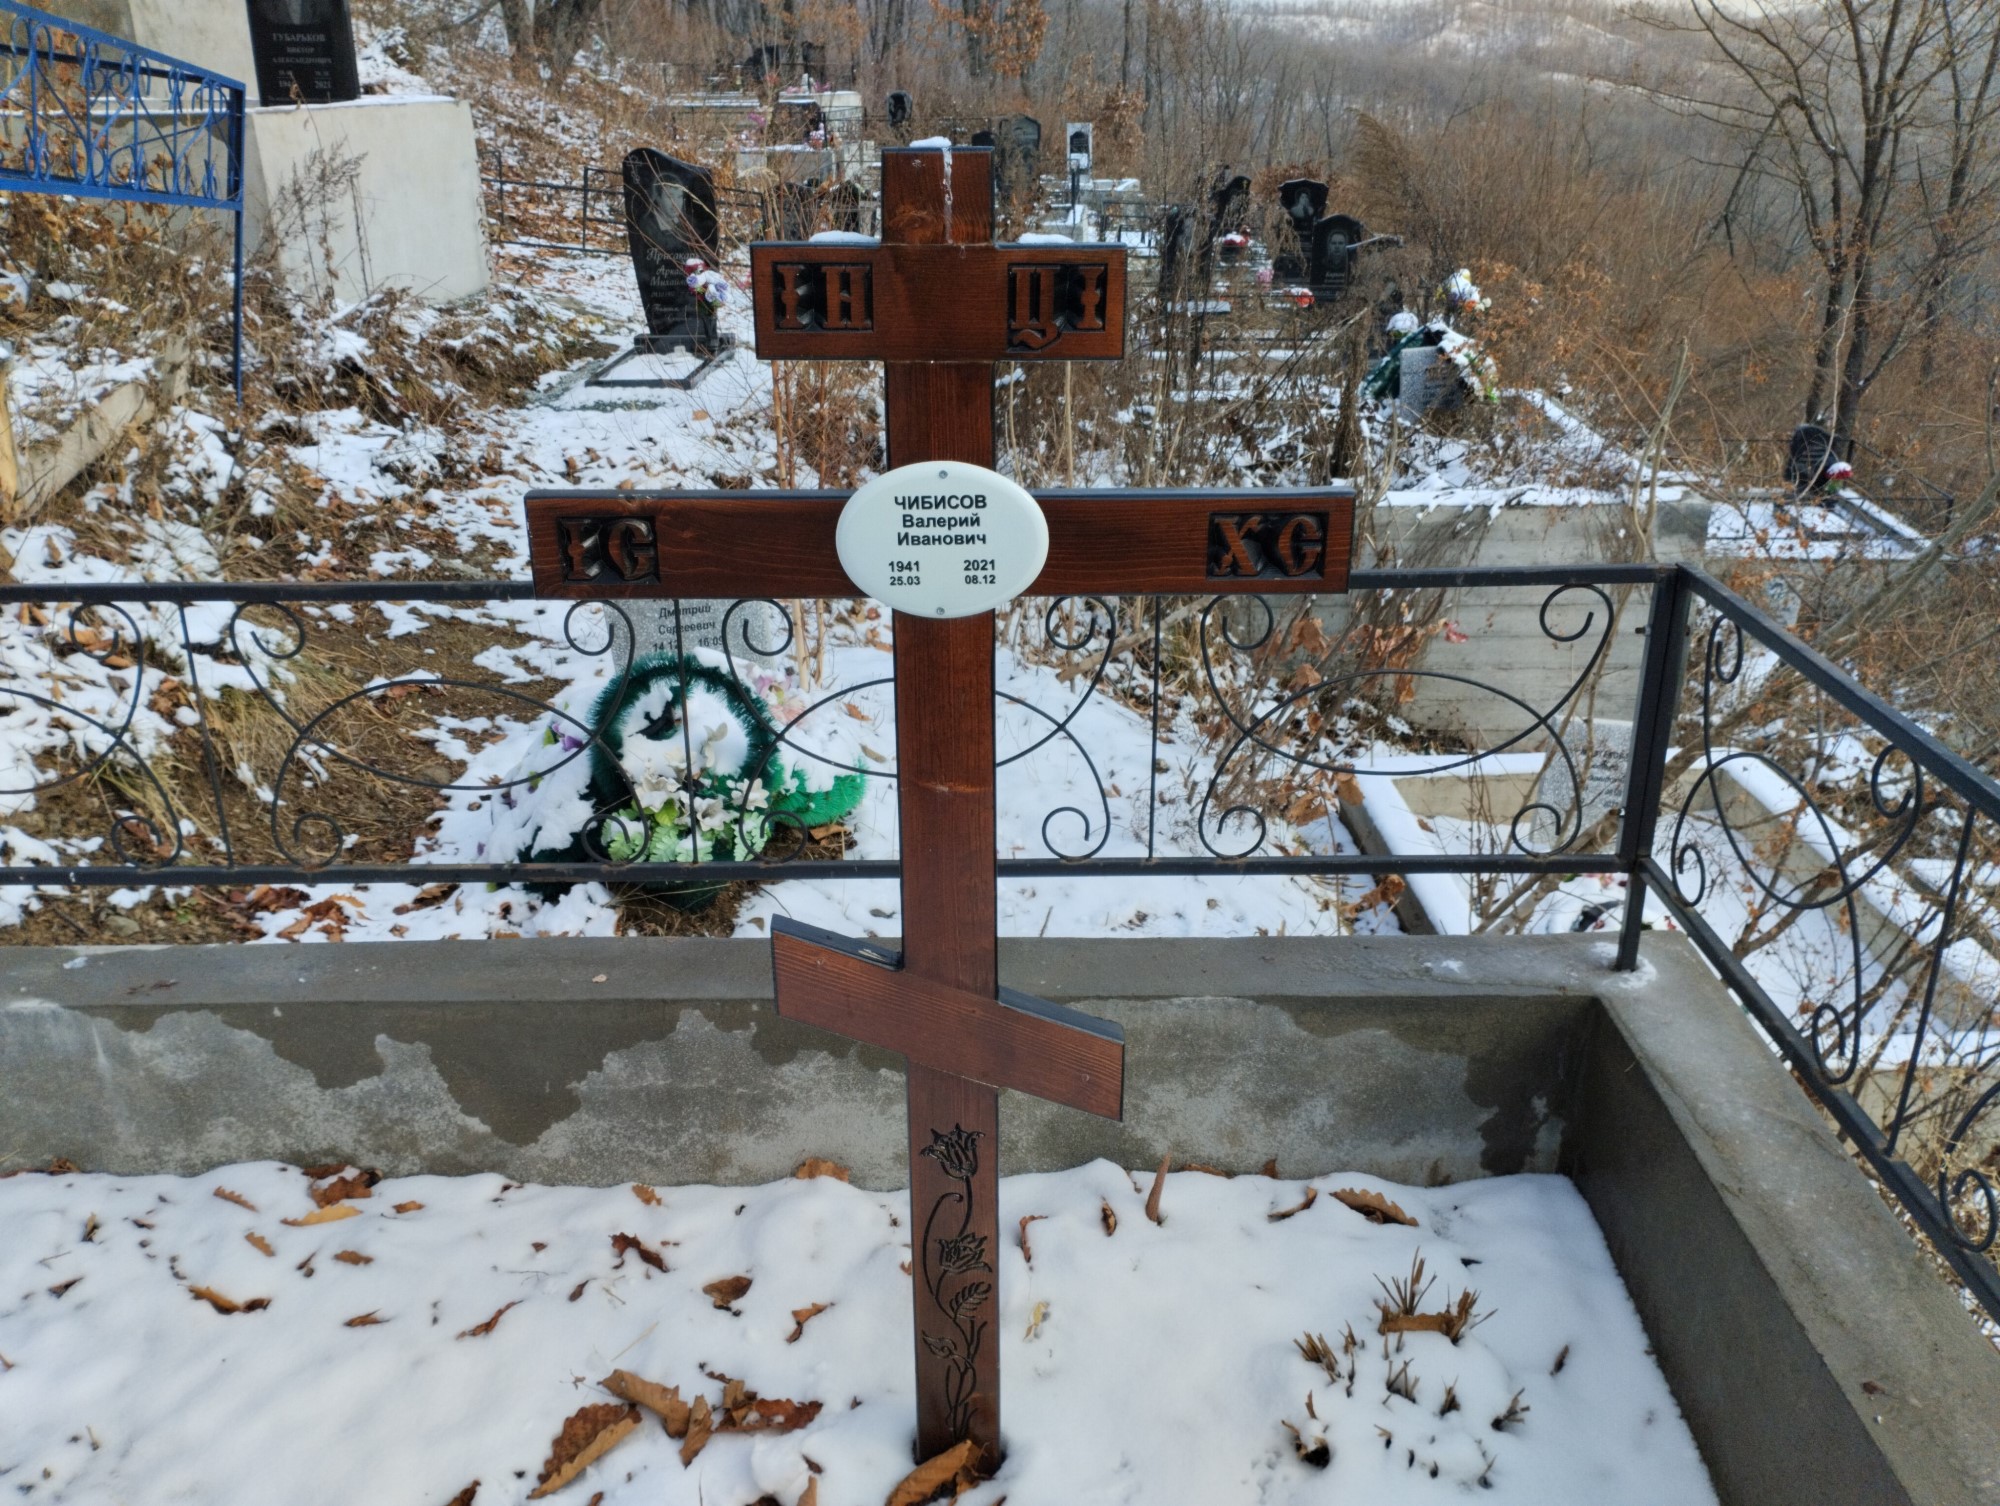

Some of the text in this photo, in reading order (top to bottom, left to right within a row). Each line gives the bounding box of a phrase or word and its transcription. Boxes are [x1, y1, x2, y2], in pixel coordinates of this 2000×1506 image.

[894, 494, 988, 510] ЧИБИСОВ
[902, 513, 981, 530] Валерий
[897, 531, 987, 546] Иванович
[888, 559, 996, 572] 1941 2021
[889, 574, 996, 586] 25.03 08.12
[659, 604, 711, 619] Дмтрий
